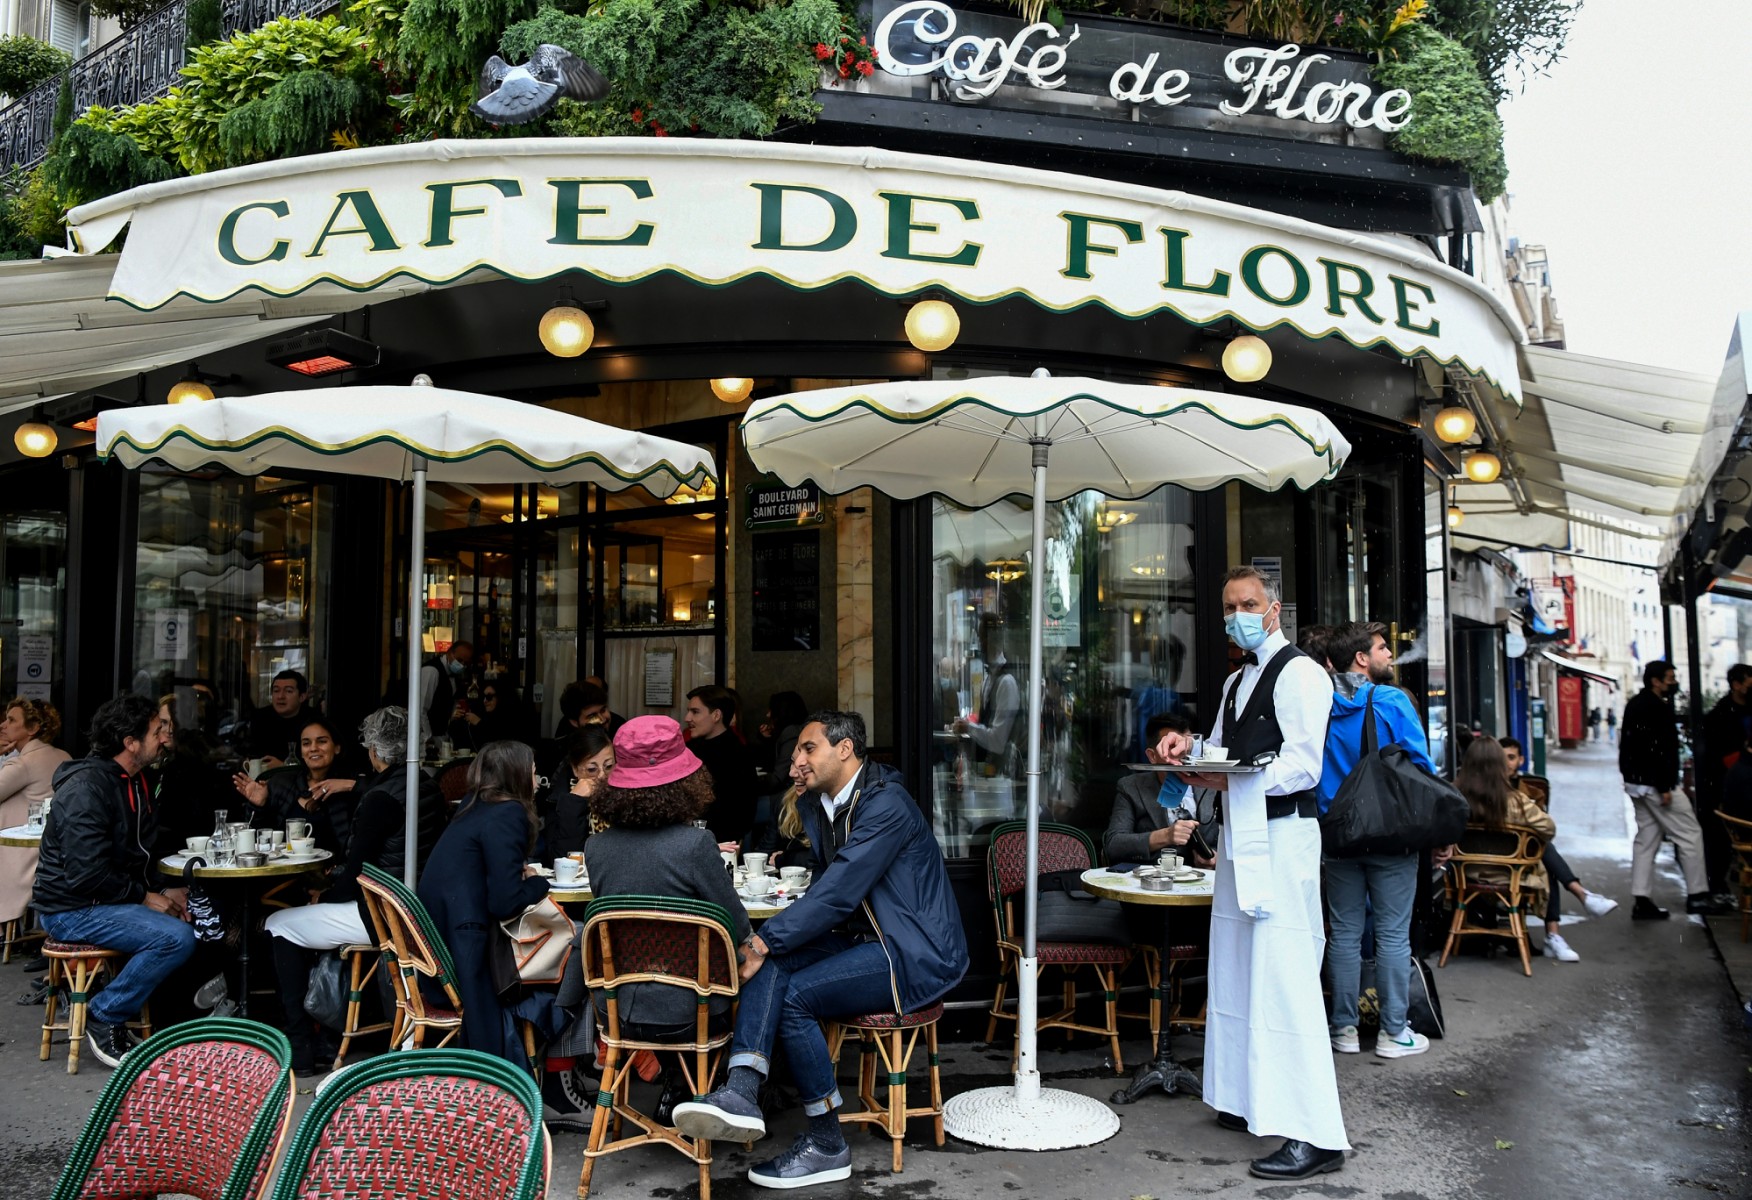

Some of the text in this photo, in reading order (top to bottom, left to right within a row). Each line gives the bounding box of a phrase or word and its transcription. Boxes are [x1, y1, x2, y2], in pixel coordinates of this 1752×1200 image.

[874, 0, 1413, 132] Café de Flore
[216, 177, 1442, 338] CAFE DE FLORE
[758, 488, 809, 505] BOULEVARD
[753, 501, 816, 518] SAINT GERMAIN
[793, 545, 816, 560] FLORE
